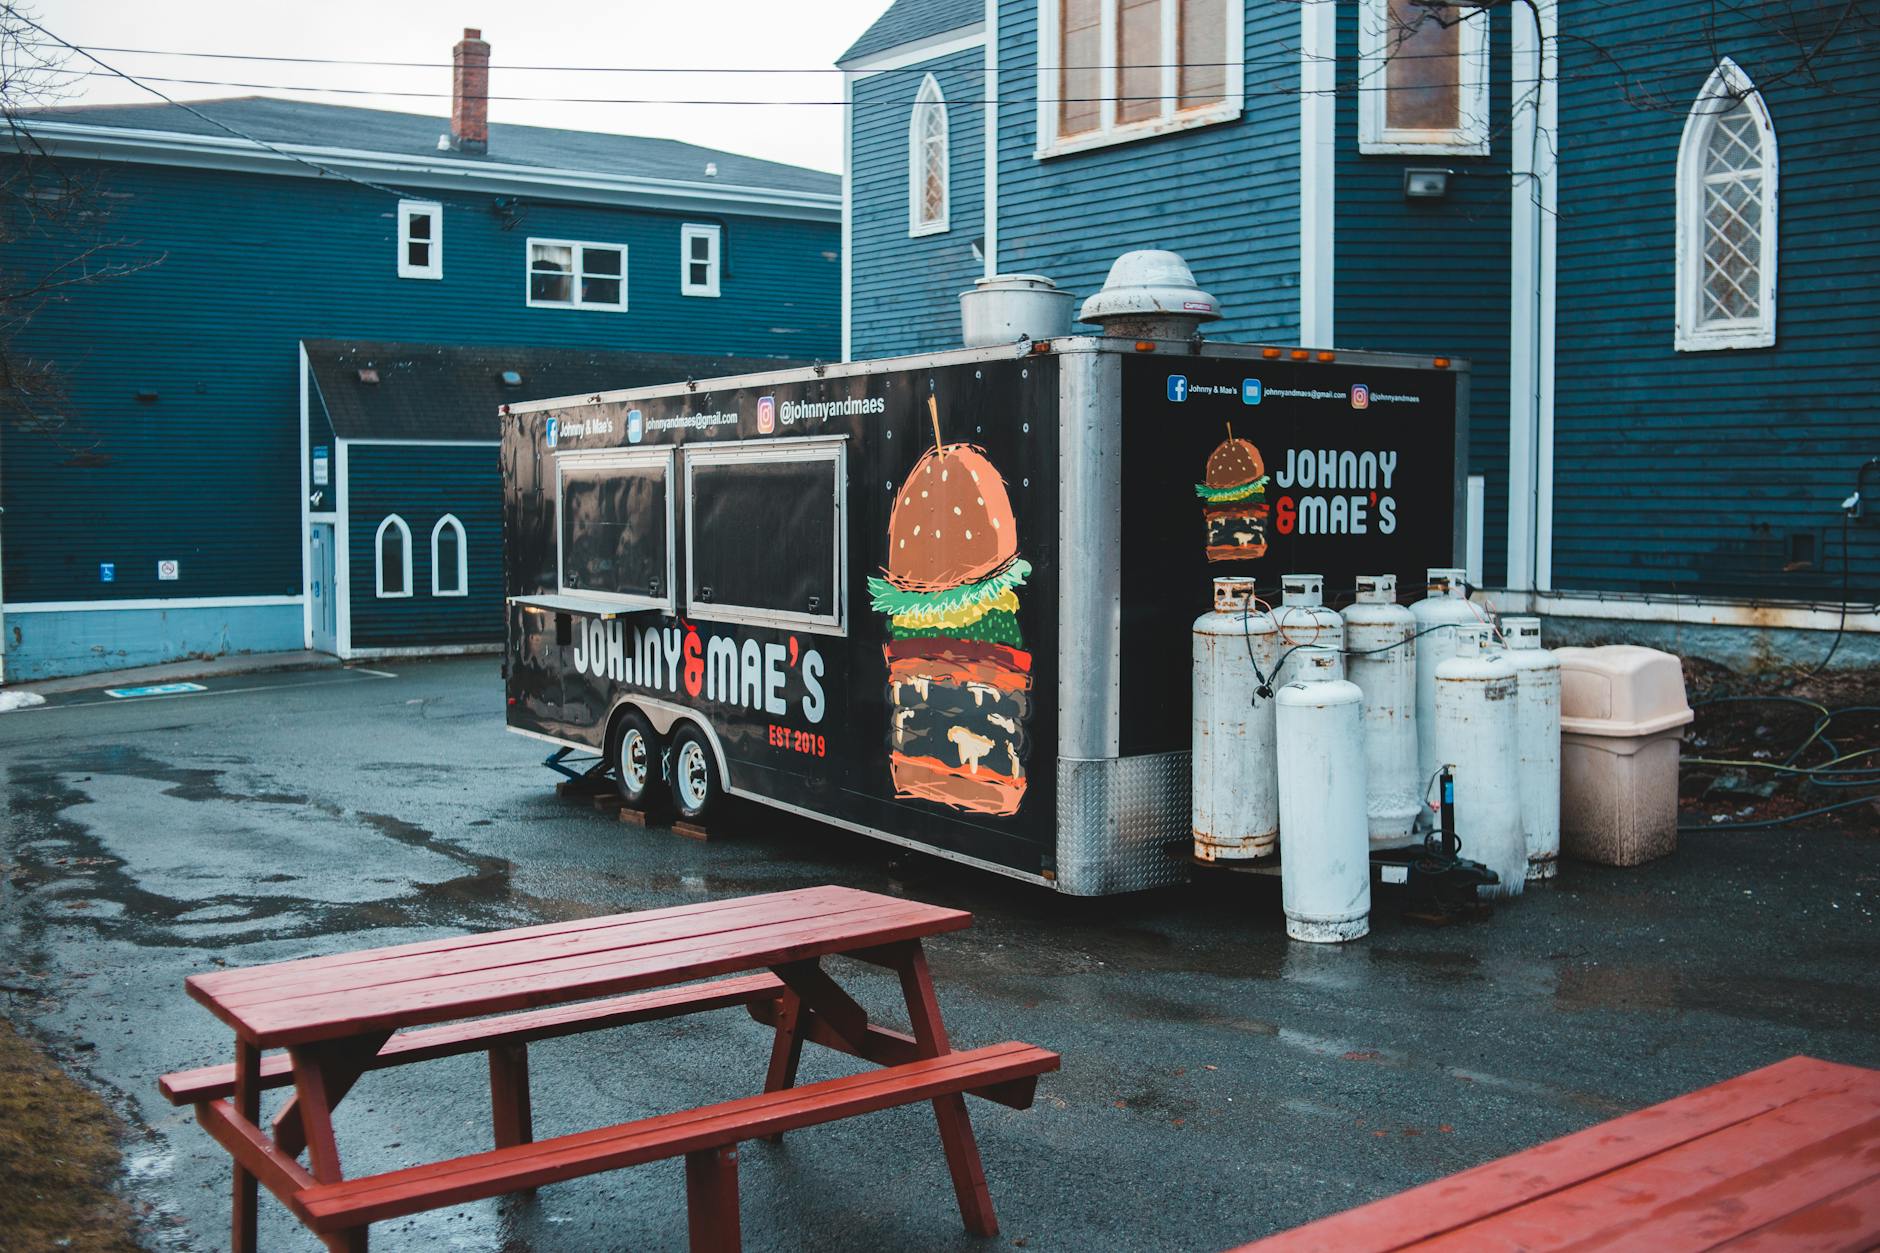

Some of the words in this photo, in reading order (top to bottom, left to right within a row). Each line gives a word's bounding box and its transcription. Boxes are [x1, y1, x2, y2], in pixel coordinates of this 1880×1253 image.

[1188, 385, 1212, 395] Johnny
[1213, 385, 1219, 394] &
[1220, 386, 1237, 395] Mae's
[1263, 387, 1347, 400] johnnyandmaes@gmail.com
[780, 396, 885, 425] @johnnyandmaes
[560, 421, 585, 439] Johnny
[585, 419, 592, 436] &
[592, 418, 613, 434] Mae's
[645, 411, 738, 434] johnnyandmaes@gmail.com
[1276, 449, 1397, 489] JOHNNY
[769, 724, 791, 749] EST
[794, 730, 826, 757] 2019
